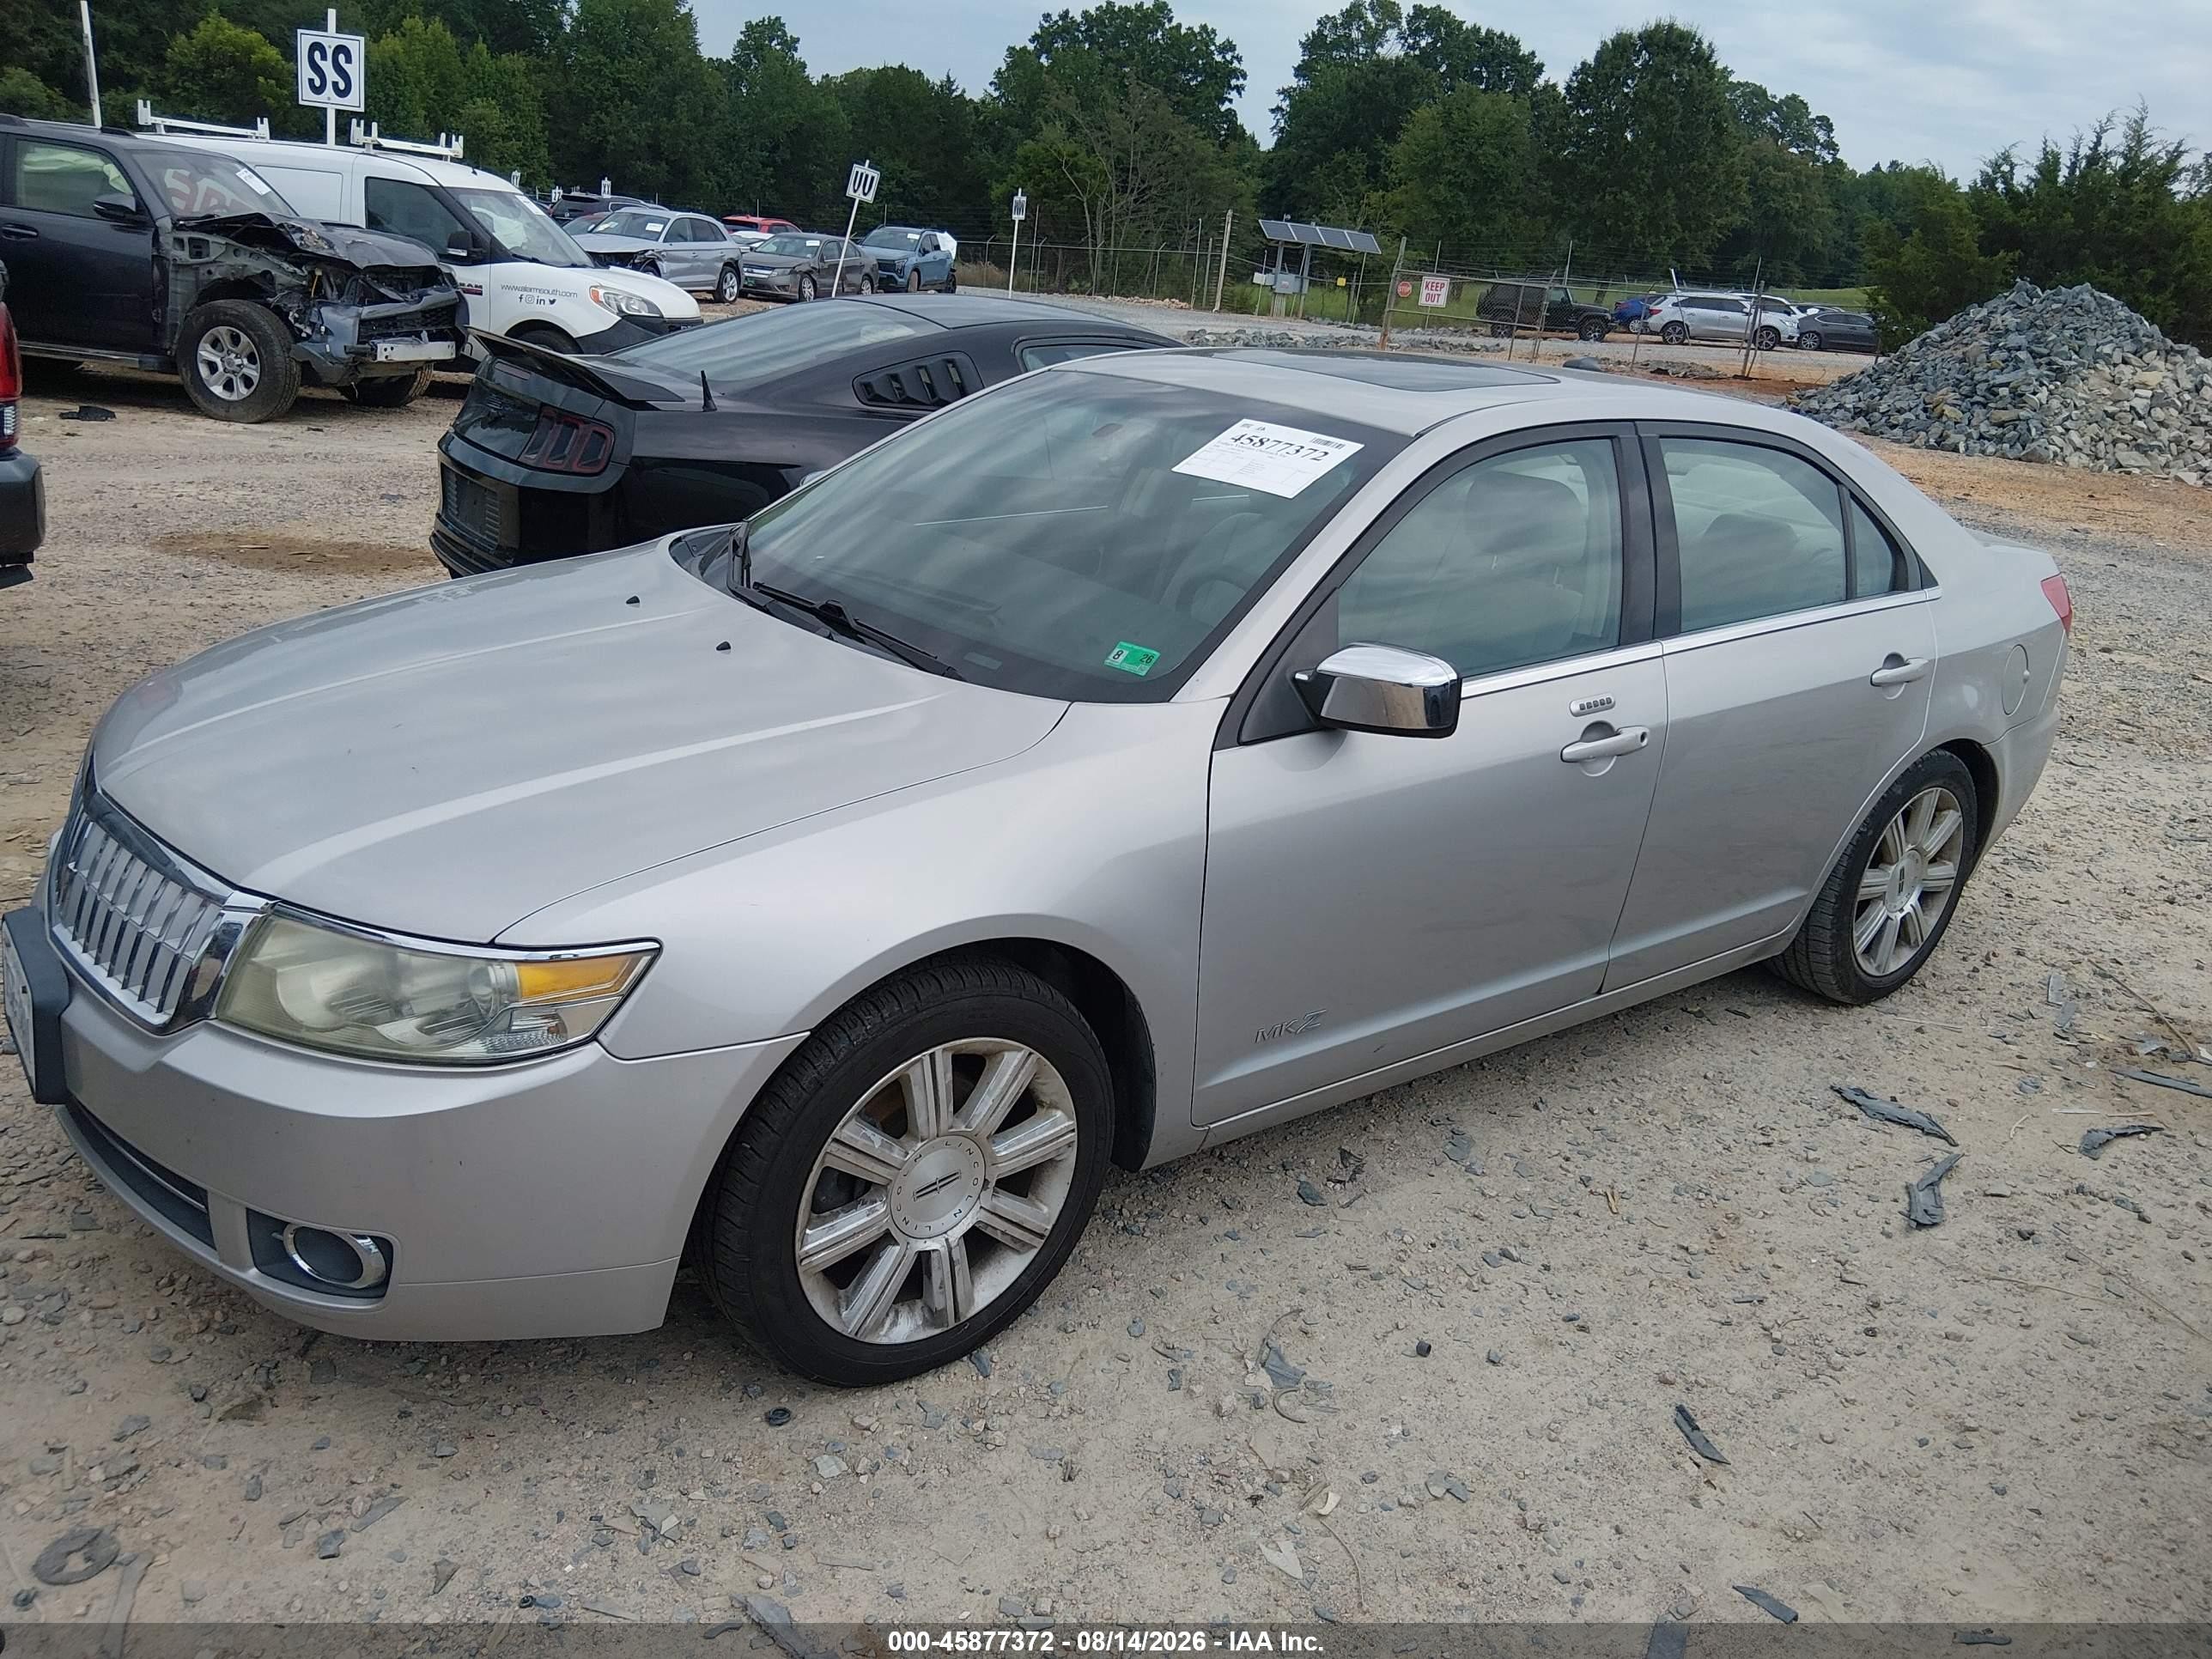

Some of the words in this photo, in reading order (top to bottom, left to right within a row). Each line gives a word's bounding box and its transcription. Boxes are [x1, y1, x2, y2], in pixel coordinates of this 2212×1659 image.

[307, 41, 353, 99] SS
[853, 170, 875, 197] UU
[1425, 281, 1446, 292] KEEP
[1425, 293, 1442, 303] OUT
[1231, 433, 1329, 461] 45877372
[1112, 649, 1124, 660] 8
[1139, 653, 1155, 665] 26
